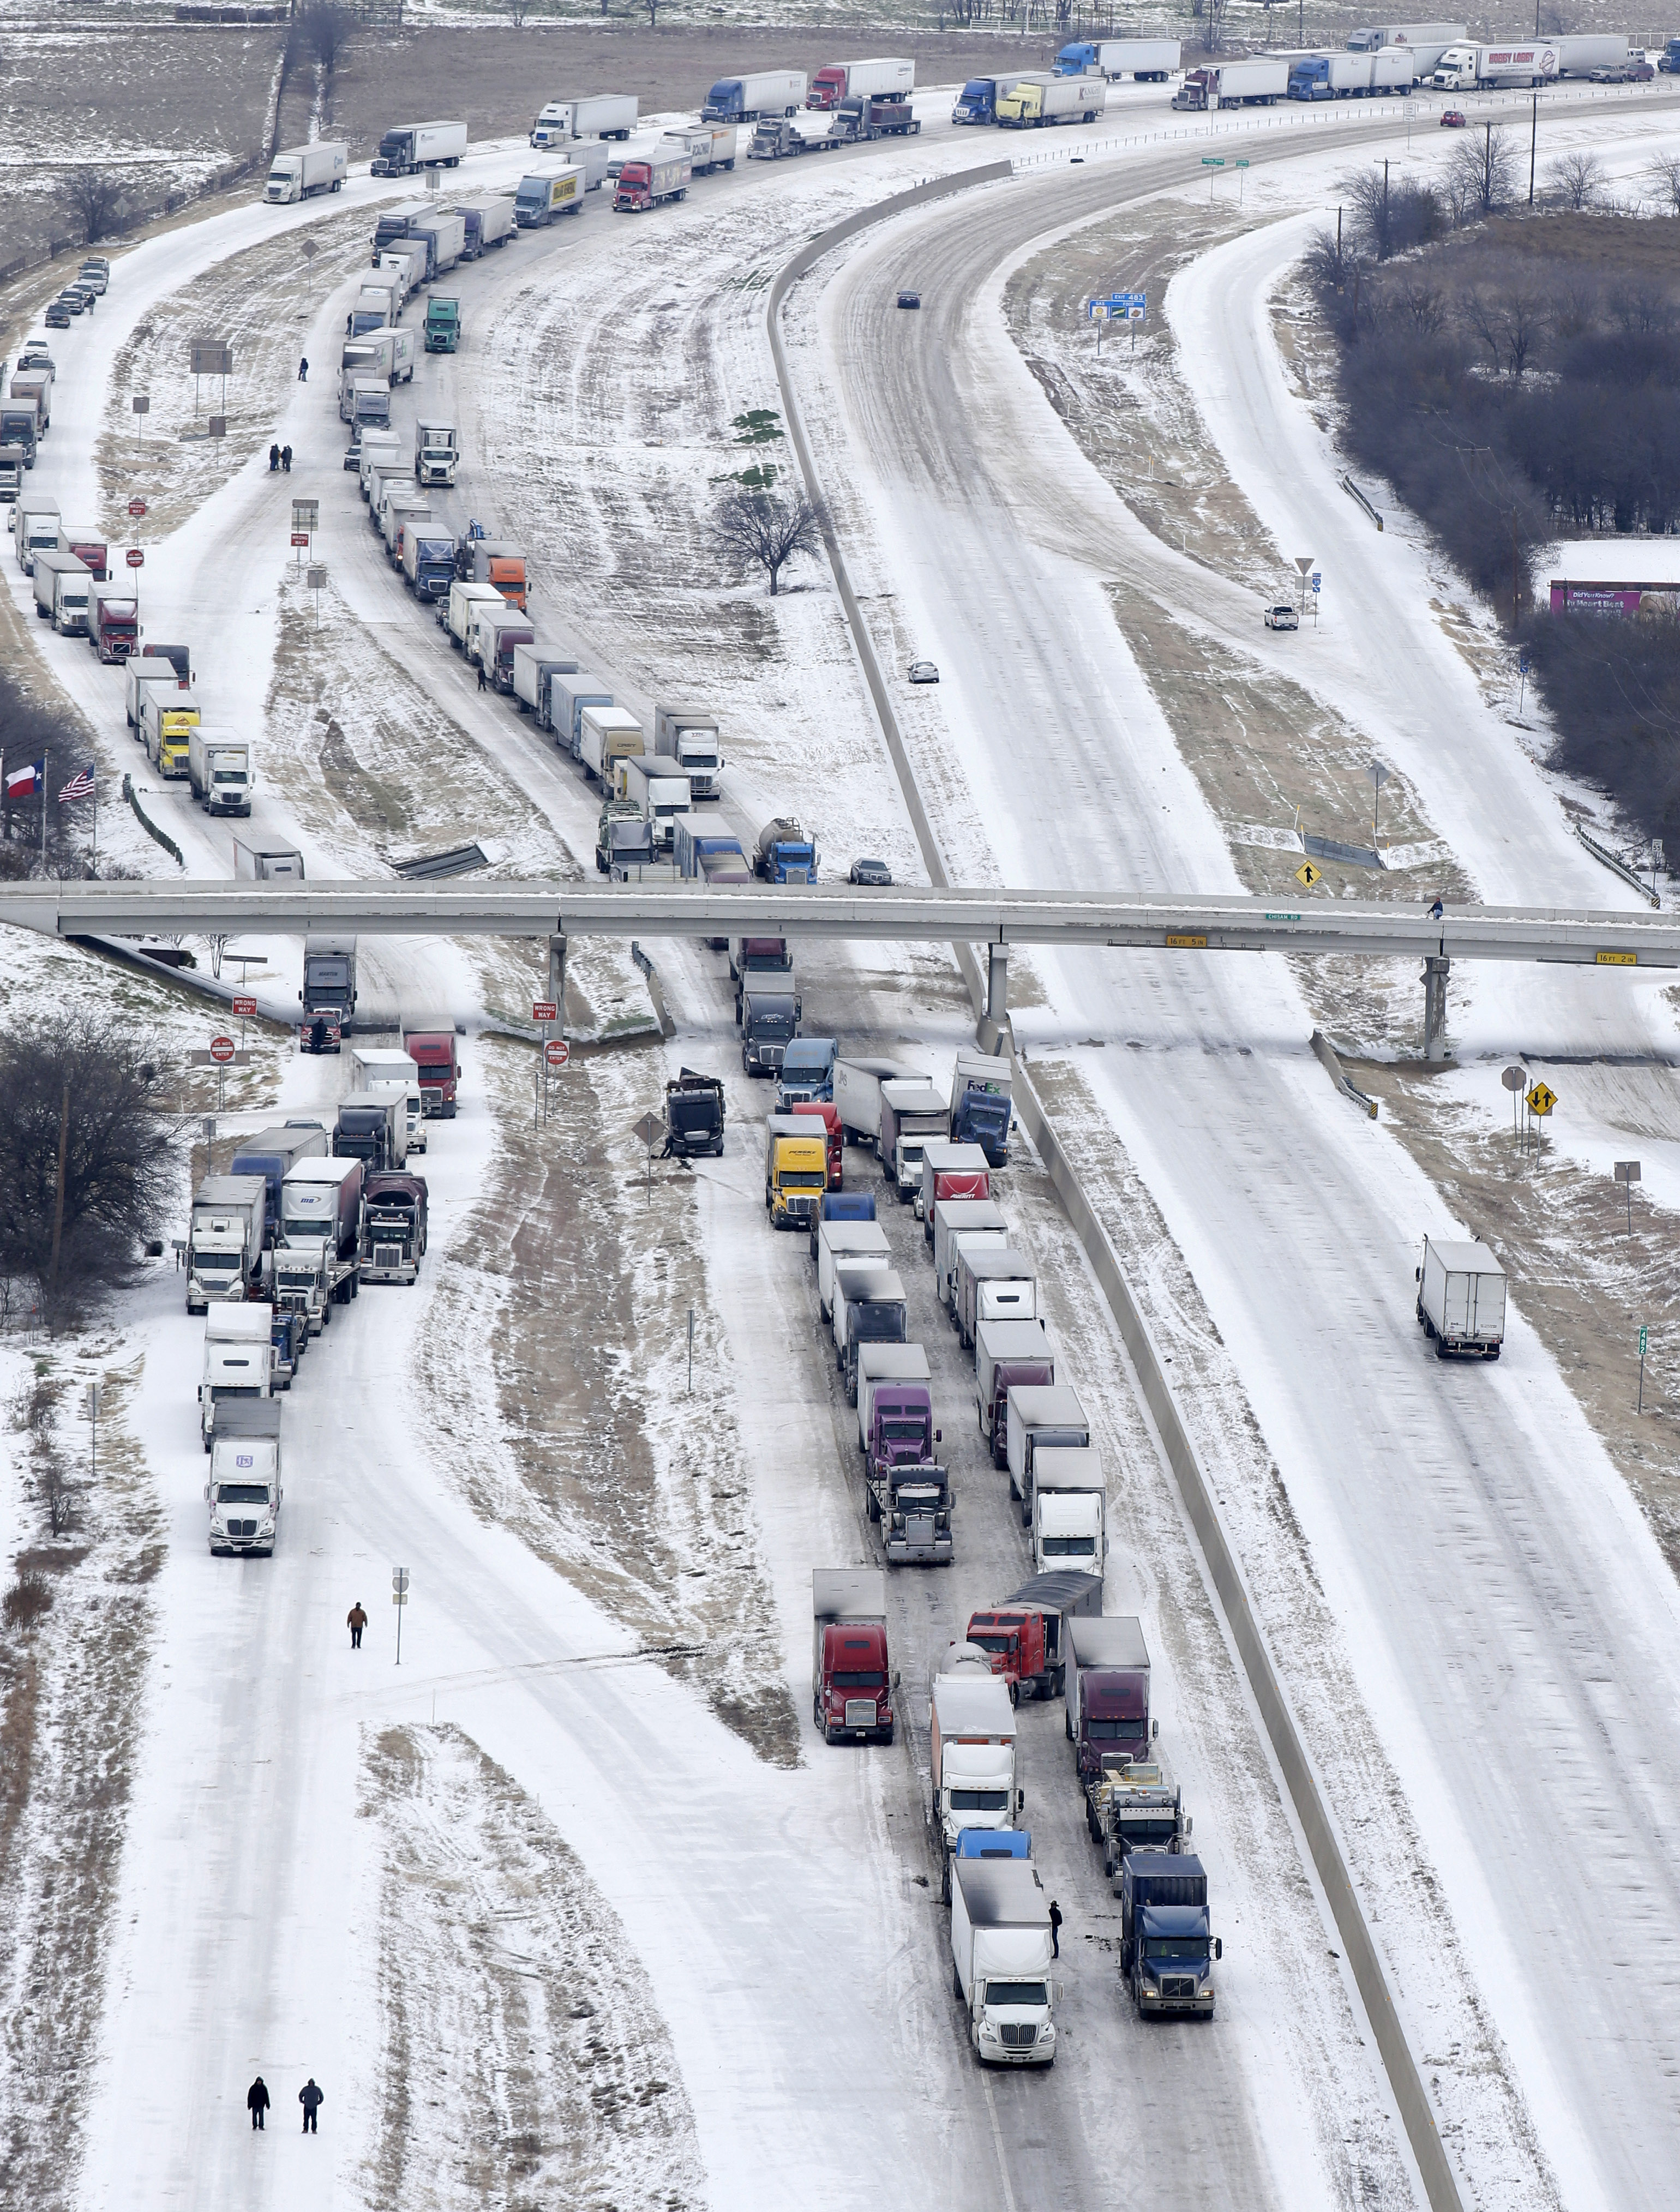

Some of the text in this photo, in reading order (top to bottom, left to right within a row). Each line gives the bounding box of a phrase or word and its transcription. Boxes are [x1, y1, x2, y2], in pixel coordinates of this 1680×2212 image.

[1489, 52, 1511, 64] HOBBY
[1513, 52, 1535, 63] LOBBY
[1078, 86, 1101, 100] KNIGHT
